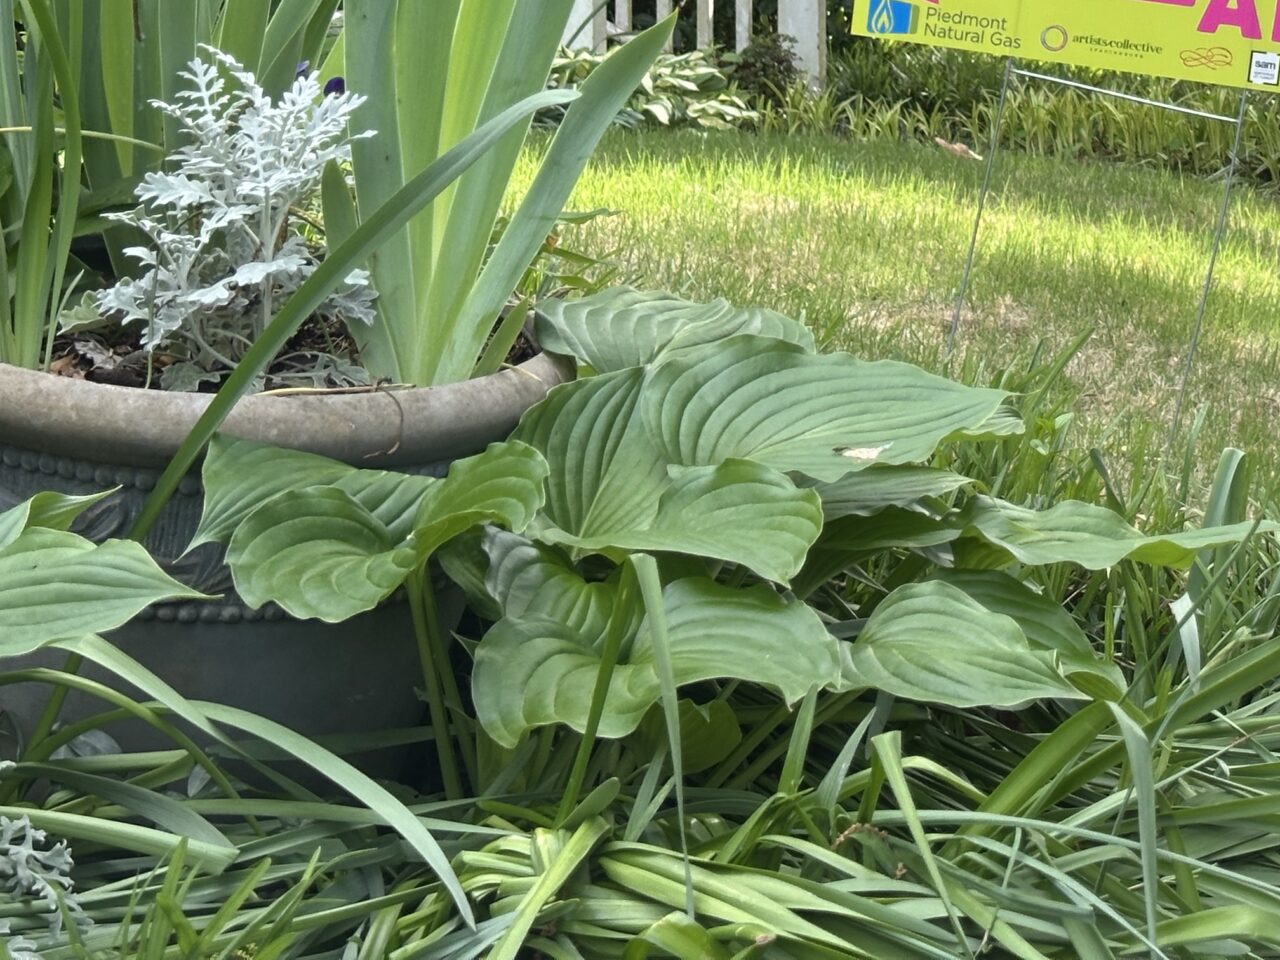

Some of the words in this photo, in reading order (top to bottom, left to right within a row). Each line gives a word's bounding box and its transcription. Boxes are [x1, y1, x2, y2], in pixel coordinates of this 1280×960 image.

[926, 6, 1008, 31] Piedmont
[924, 22, 985, 44] Natural
[990, 31, 1022, 49] Gas
[1255, 60, 1276, 70] sam
